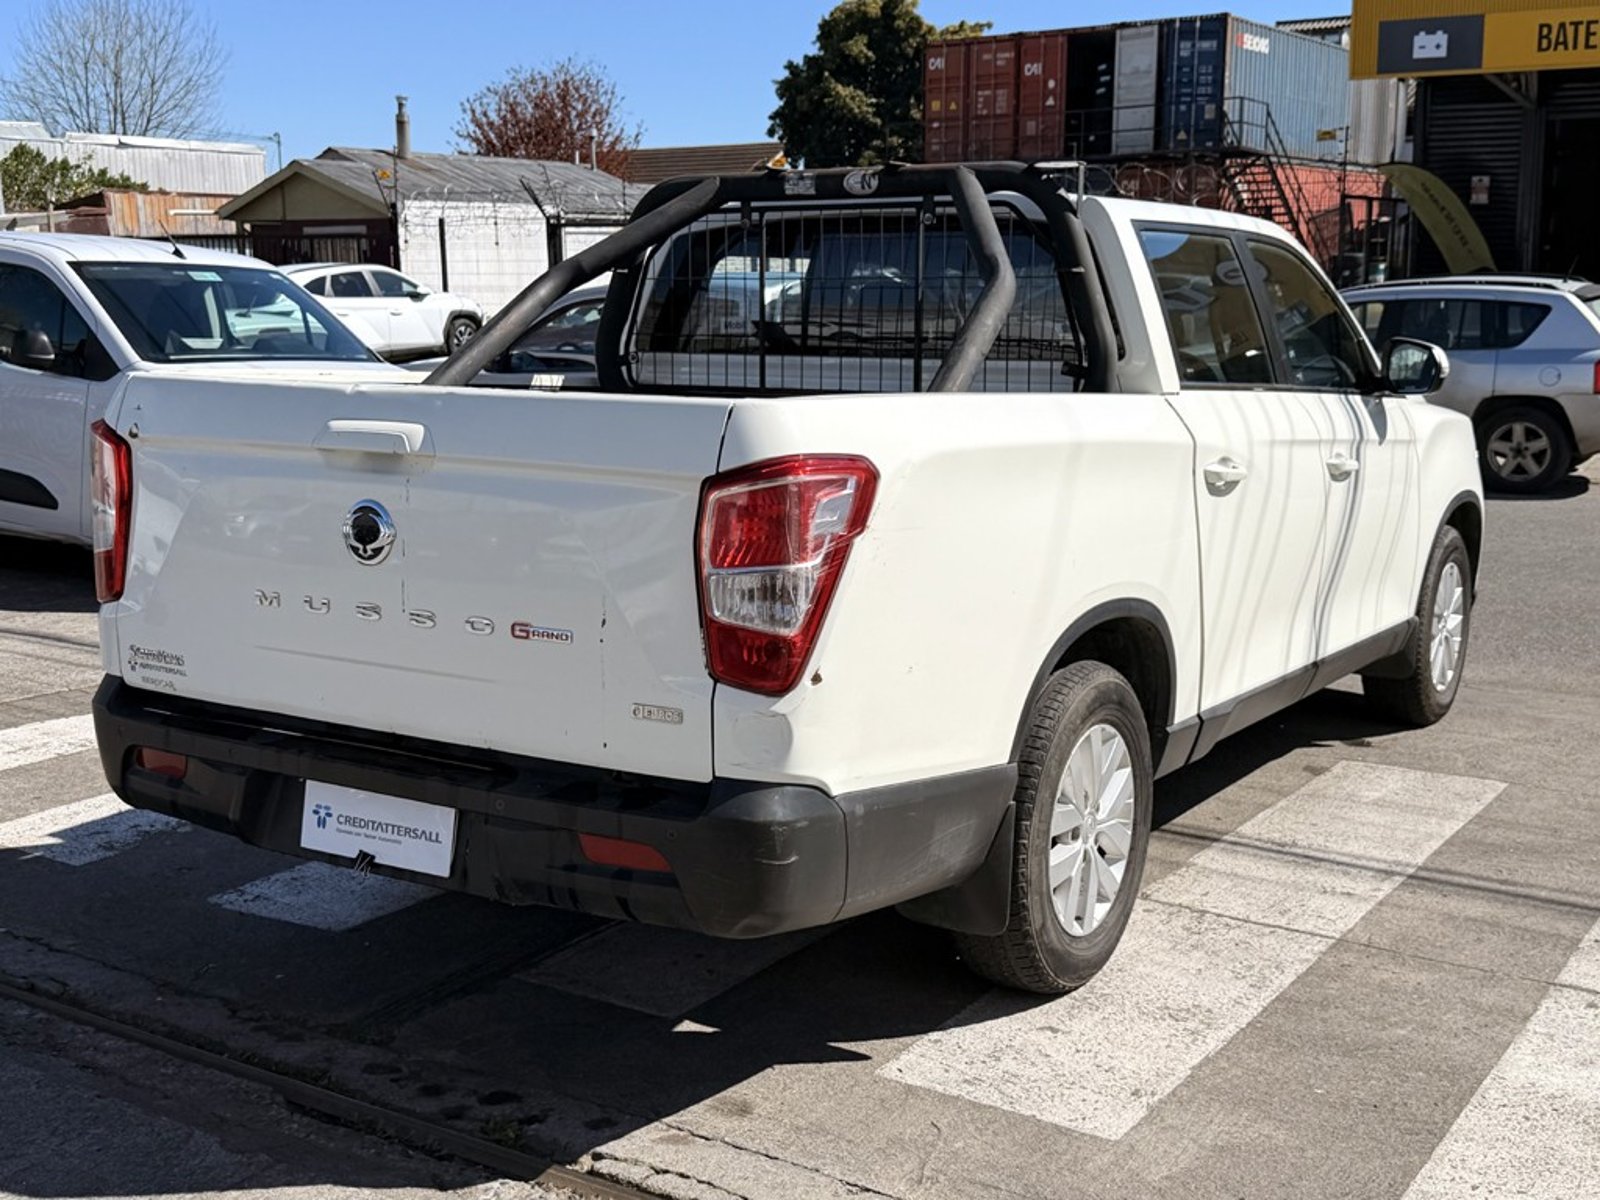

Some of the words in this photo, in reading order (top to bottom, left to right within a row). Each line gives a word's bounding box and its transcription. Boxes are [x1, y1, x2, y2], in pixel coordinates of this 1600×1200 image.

[1537, 20, 1599, 52] BATE
[254, 589, 495, 636] MUSSO
[510, 621, 571, 643] GRAND
[336, 814, 443, 844] CREDITATTERSALL
